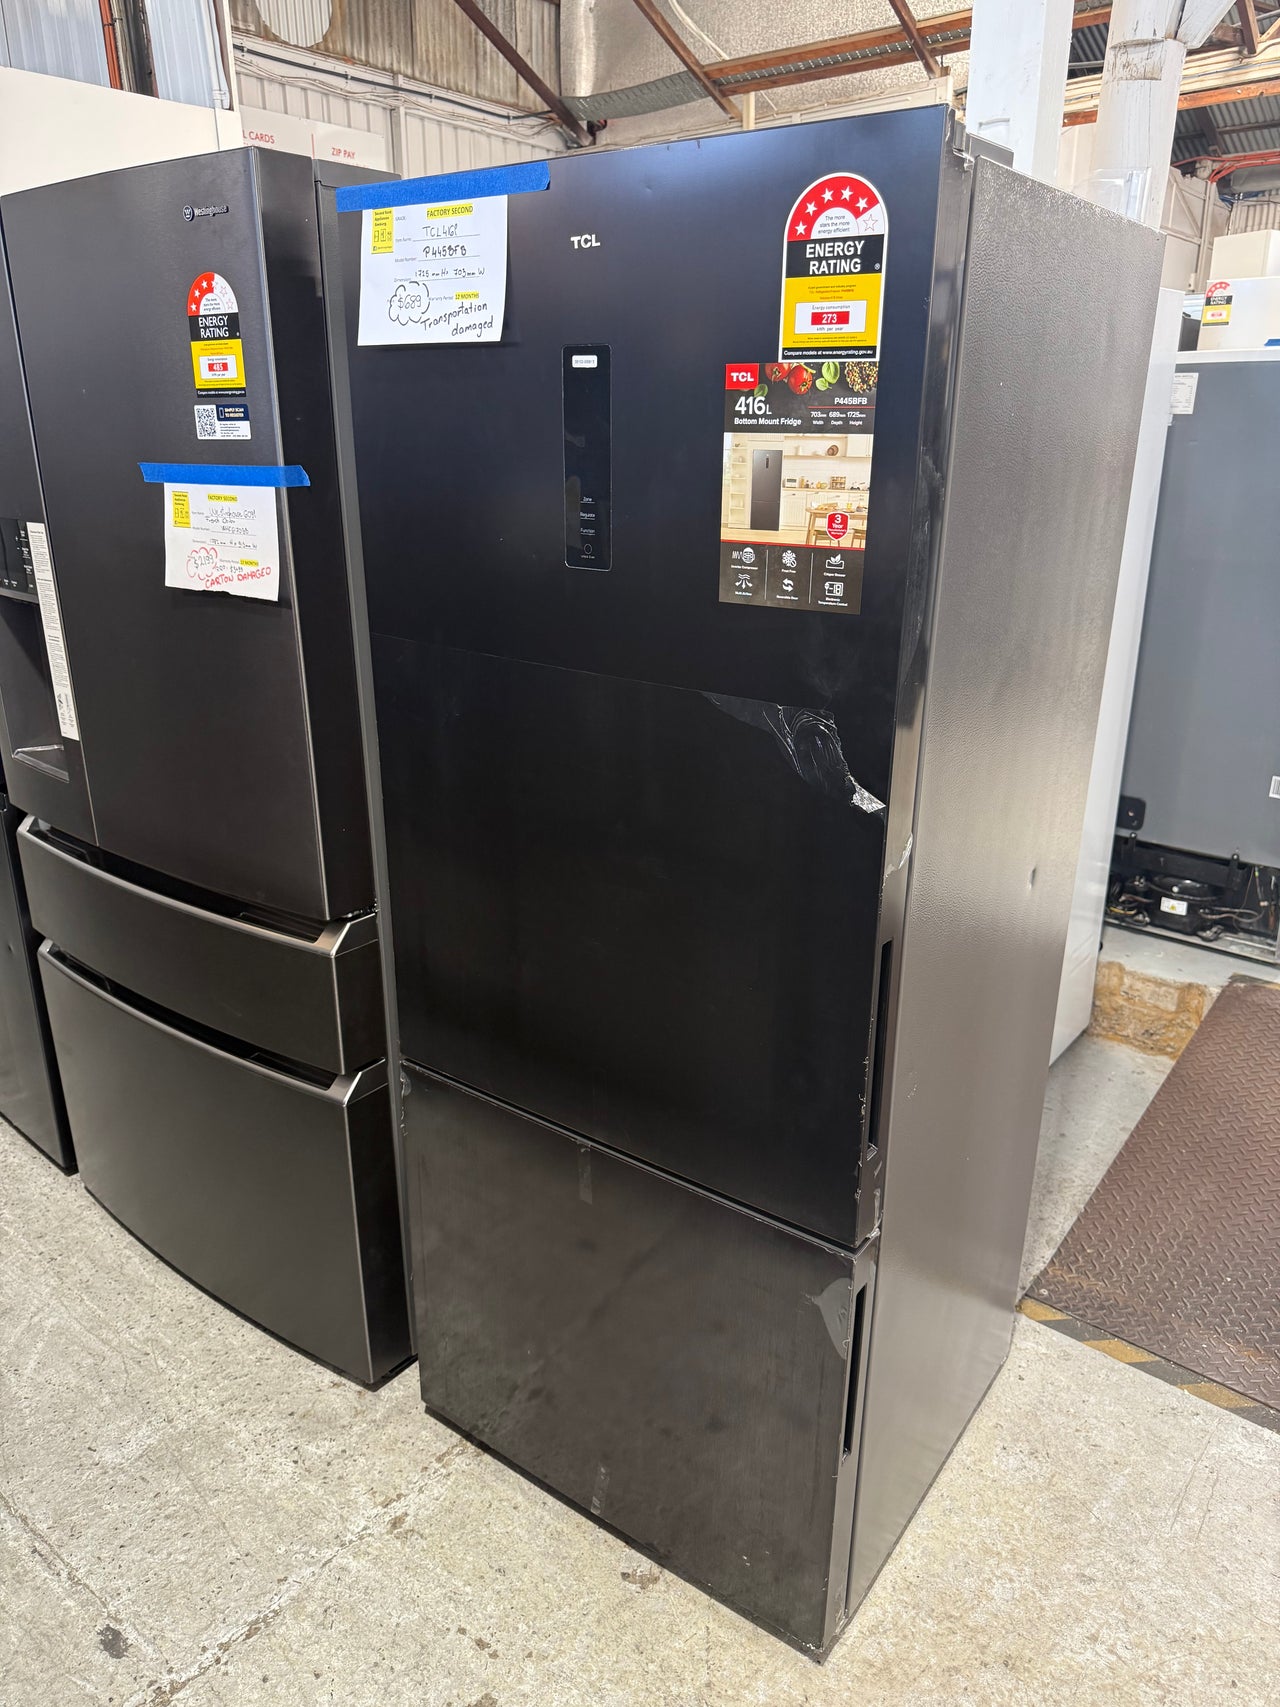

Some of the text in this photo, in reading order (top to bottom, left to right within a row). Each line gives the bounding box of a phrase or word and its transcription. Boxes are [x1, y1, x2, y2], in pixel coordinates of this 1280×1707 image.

[248, 131, 275, 144] CARDS
[331, 147, 356, 159] ZIP PAY
[194, 205, 229, 217] Westinghouse
[427, 204, 473, 218] FACTORY SECOND
[570, 233, 601, 249] TCL
[806, 240, 865, 258] ENERGY
[809, 258, 861, 275] RATING
[397, 293, 422, 310] $689
[198, 315, 228, 327] ENERGY
[420, 302, 488, 331] Transportation
[821, 313, 838, 324] 273
[200, 327, 229, 338] RATING
[451, 315, 494, 338] damaged
[213, 363, 223, 371] 485
[731, 372, 754, 382] TCL
[834, 397, 868, 405] P445BFB
[734, 417, 757, 425] Bottom
[780, 418, 802, 426] Fridge
[834, 514, 842, 523] 3
[205, 566, 272, 589] CARTON DAMAGED
